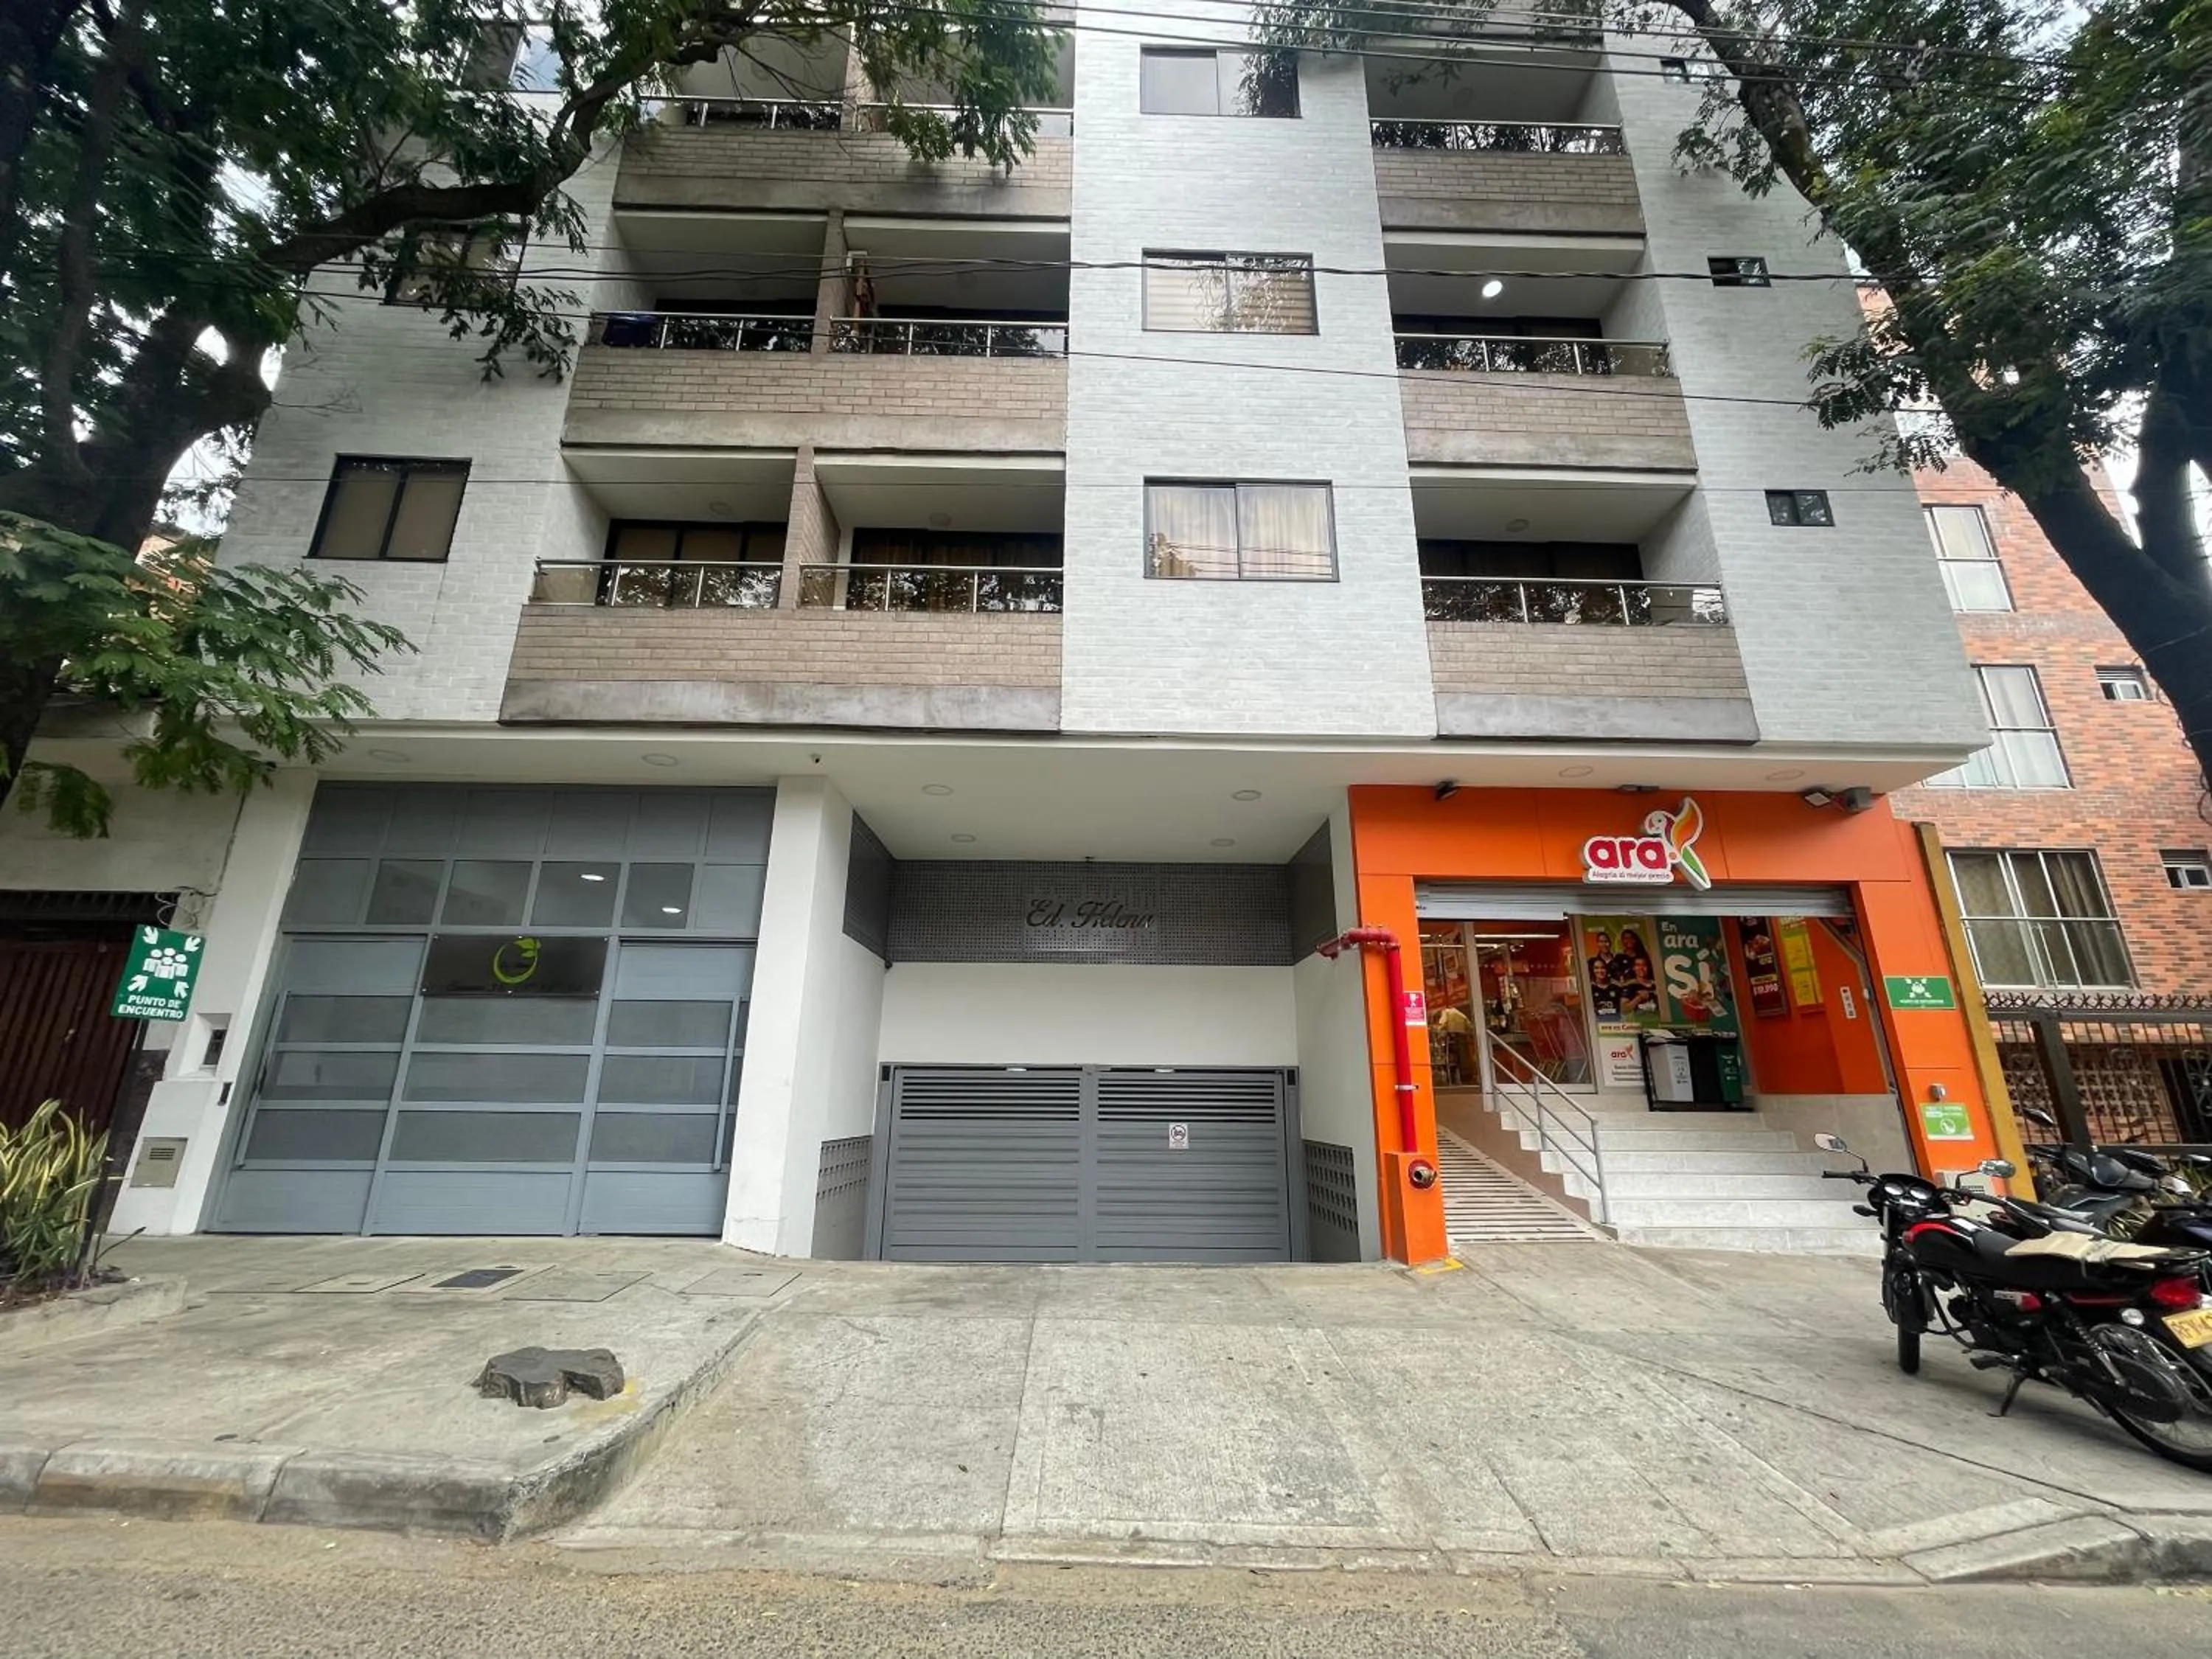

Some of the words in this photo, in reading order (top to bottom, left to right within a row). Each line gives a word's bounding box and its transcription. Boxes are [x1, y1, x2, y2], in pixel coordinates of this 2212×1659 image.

[1588, 839, 1668, 869] ara
[1648, 872, 1670, 880] precio
[1026, 899, 1065, 928] Ed.
[1661, 922, 1677, 932] En
[1663, 933, 1699, 948] ara
[128, 995, 166, 1006] PUNTO
[167, 999, 181, 1009] DE
[118, 1004, 184, 1019] ENCUENTRO
[1610, 1049, 1627, 1059] ara
